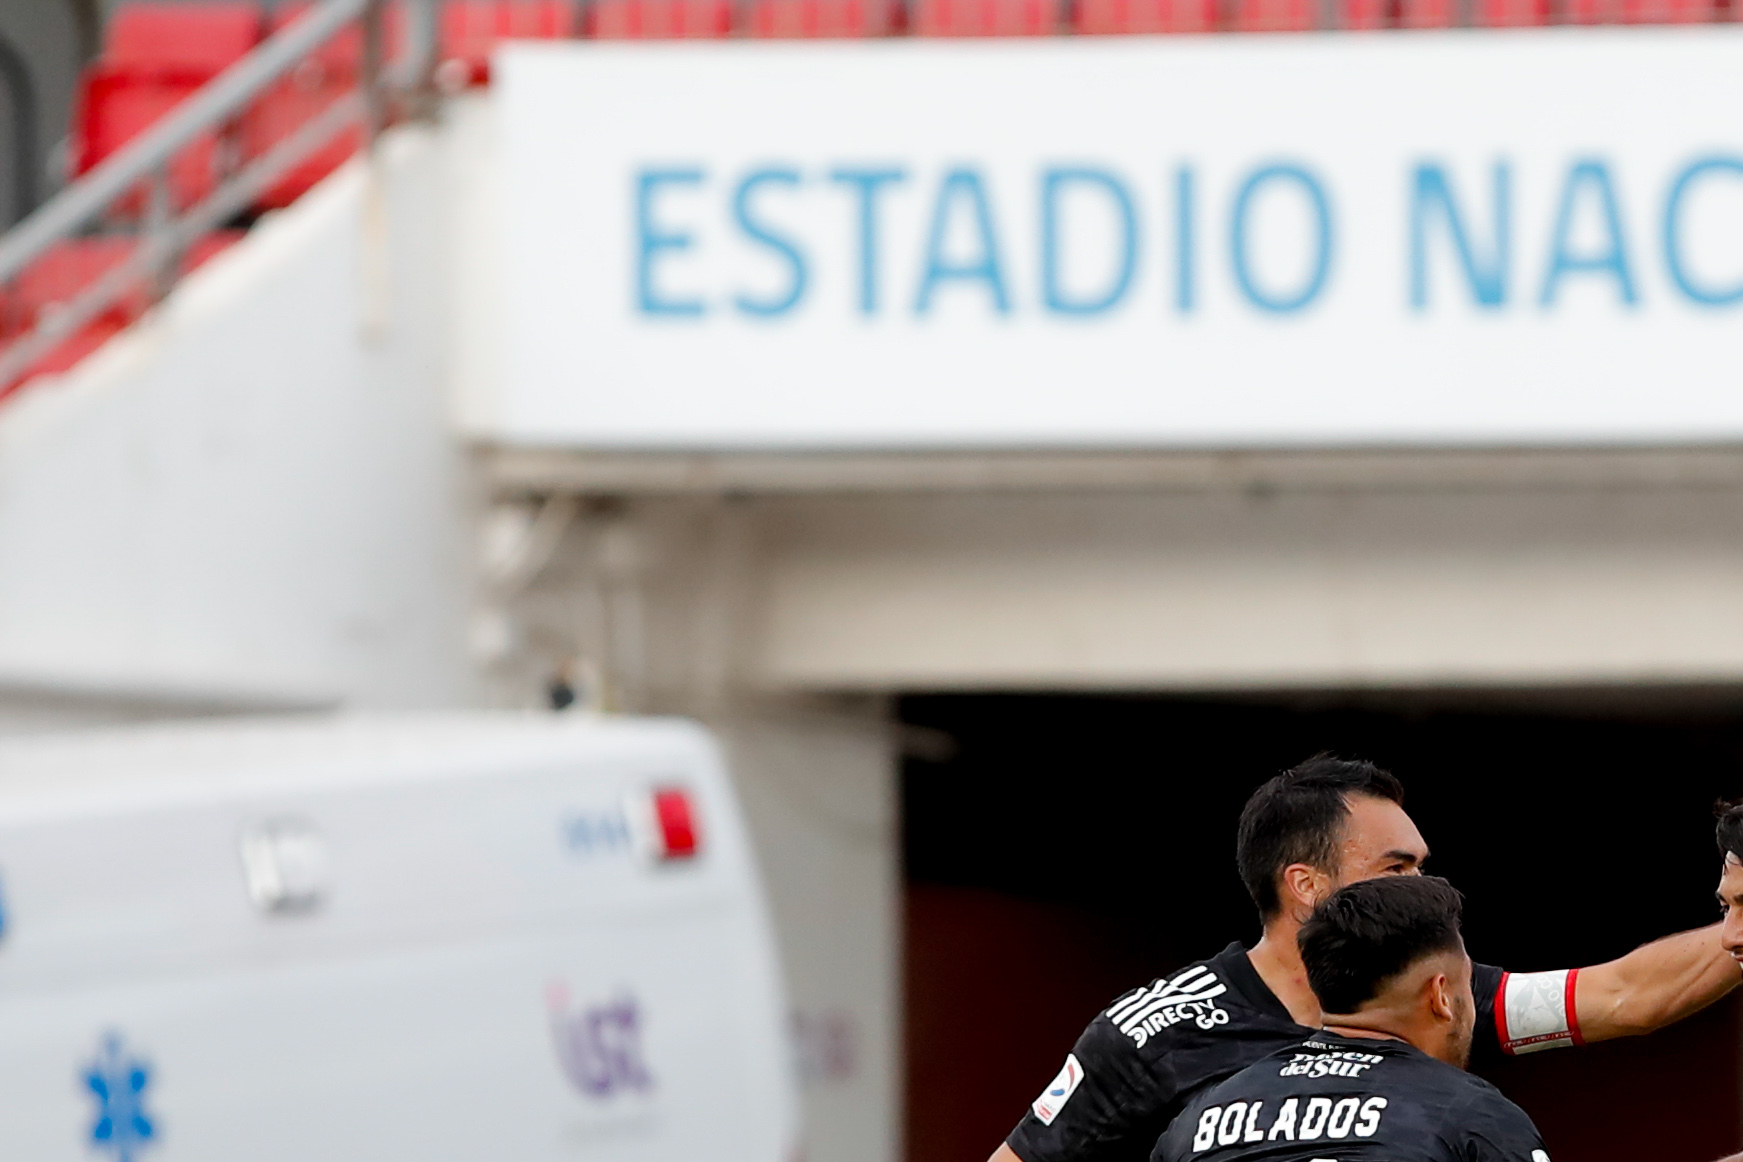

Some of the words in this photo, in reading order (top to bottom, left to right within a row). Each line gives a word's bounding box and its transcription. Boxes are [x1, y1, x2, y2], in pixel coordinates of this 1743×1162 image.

[632, 160, 1337, 318] ESTADIO
[1127, 998, 1215, 1049] DIRECTV
[1195, 1008, 1229, 1030] GO
[1308, 1058, 1371, 1078] Sur
[1193, 1097, 1388, 1152] BOLADOS
